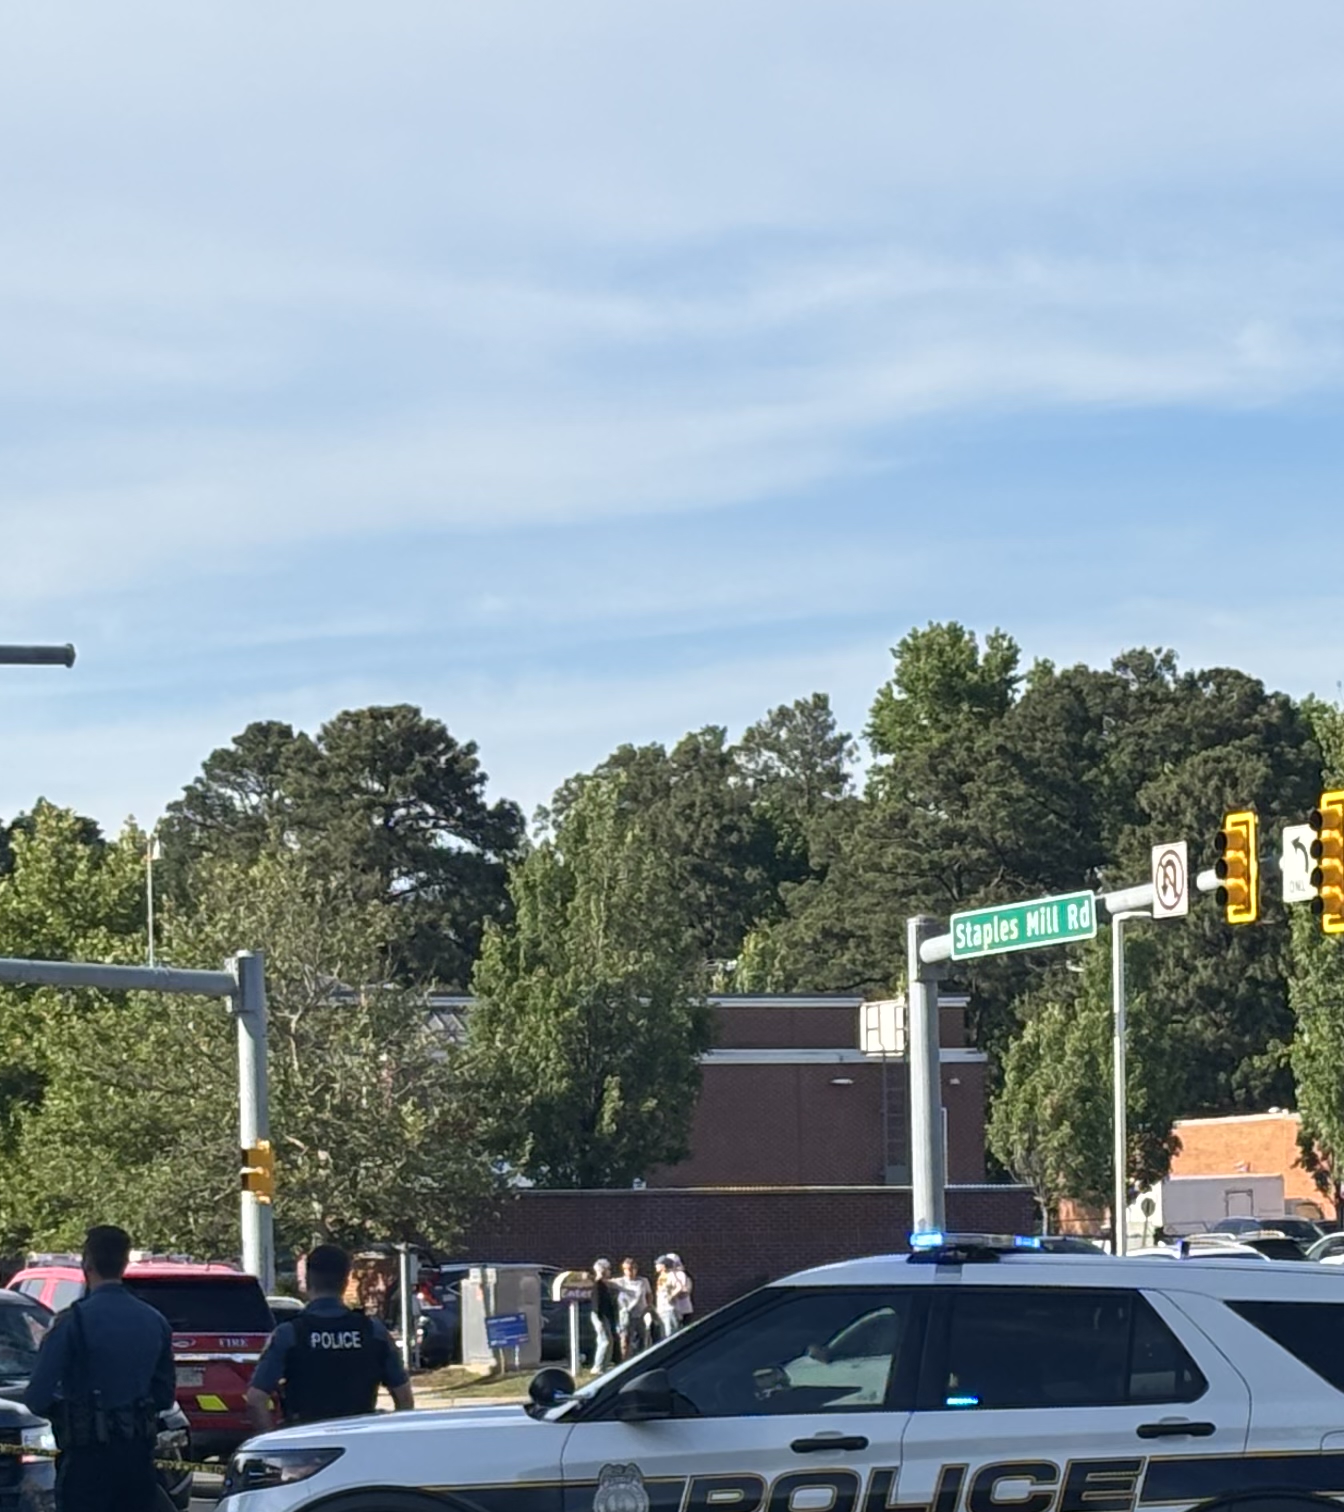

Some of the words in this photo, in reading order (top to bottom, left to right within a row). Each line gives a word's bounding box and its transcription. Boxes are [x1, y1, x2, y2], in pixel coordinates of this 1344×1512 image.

[955, 914, 1019, 950] Staples
[1026, 904, 1060, 938] Mill
[1067, 899, 1091, 930] Rd
[218, 1337, 250, 1349] FIRE
[310, 1330, 362, 1349] POLICE
